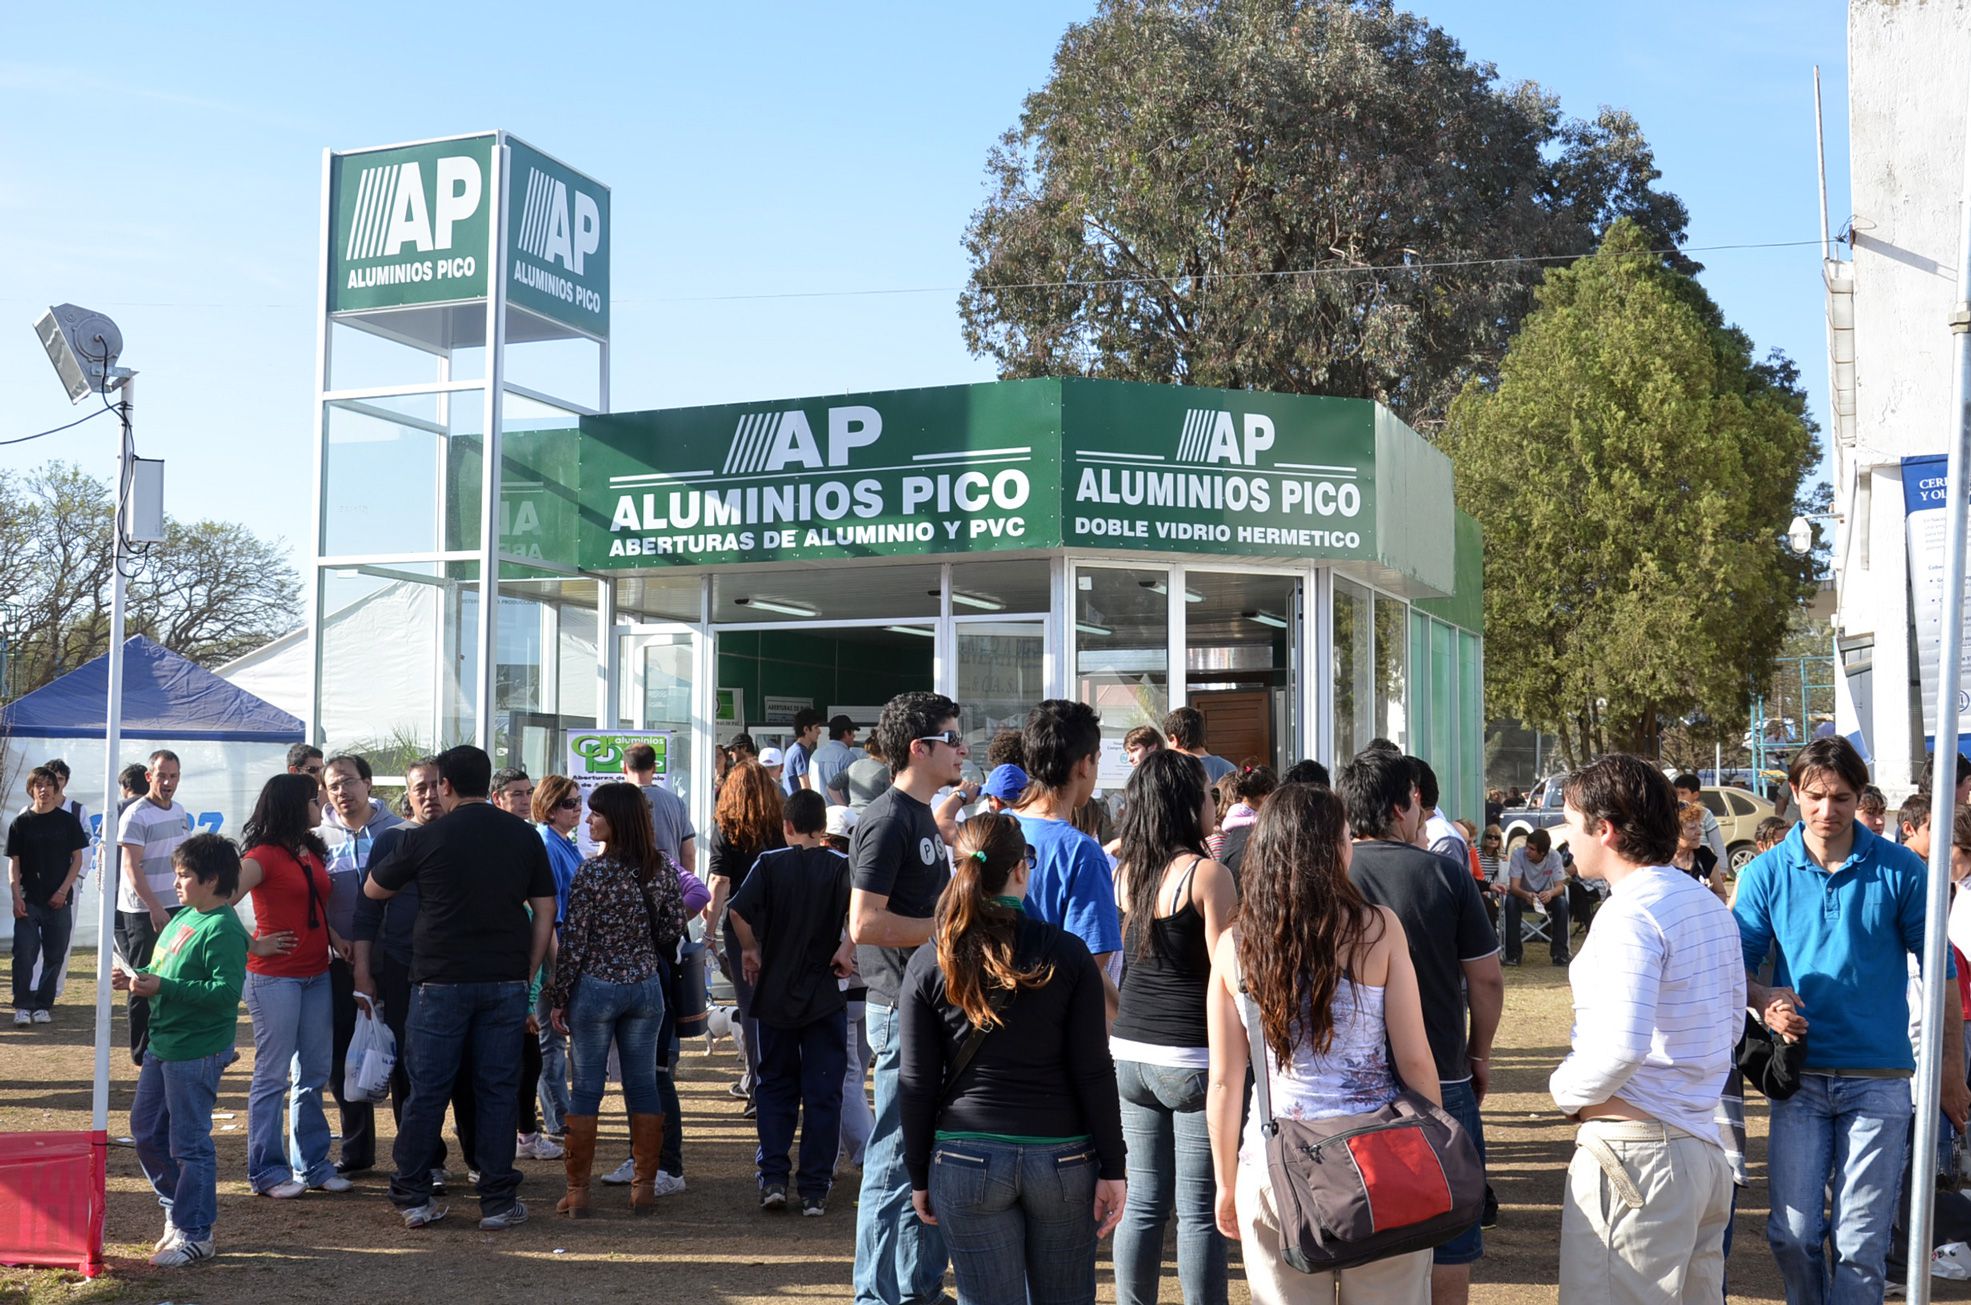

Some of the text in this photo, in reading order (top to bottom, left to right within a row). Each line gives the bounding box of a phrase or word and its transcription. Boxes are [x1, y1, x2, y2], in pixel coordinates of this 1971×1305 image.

[383, 155, 482, 255] AP
[543, 179, 601, 276] AP
[347, 256, 476, 289] ALUMINIOS PICO
[513, 259, 601, 314] ALUMINIOS PICO
[764, 406, 883, 471] AP
[1206, 411, 1276, 466] AP
[609, 468, 1031, 532] ALUMINIOS PICO
[1076, 467, 1361, 517] ALUMINIOS PICO
[1920, 491, 1929, 501] Y
[609, 516, 1025, 557] ABERTURAS DE ALUMINIO Y PVC
[1075, 517, 1360, 548] DOBLE VIDRIO HERMETICO
[614, 737, 664, 745] aluminios
[924, 844, 931, 859] P
